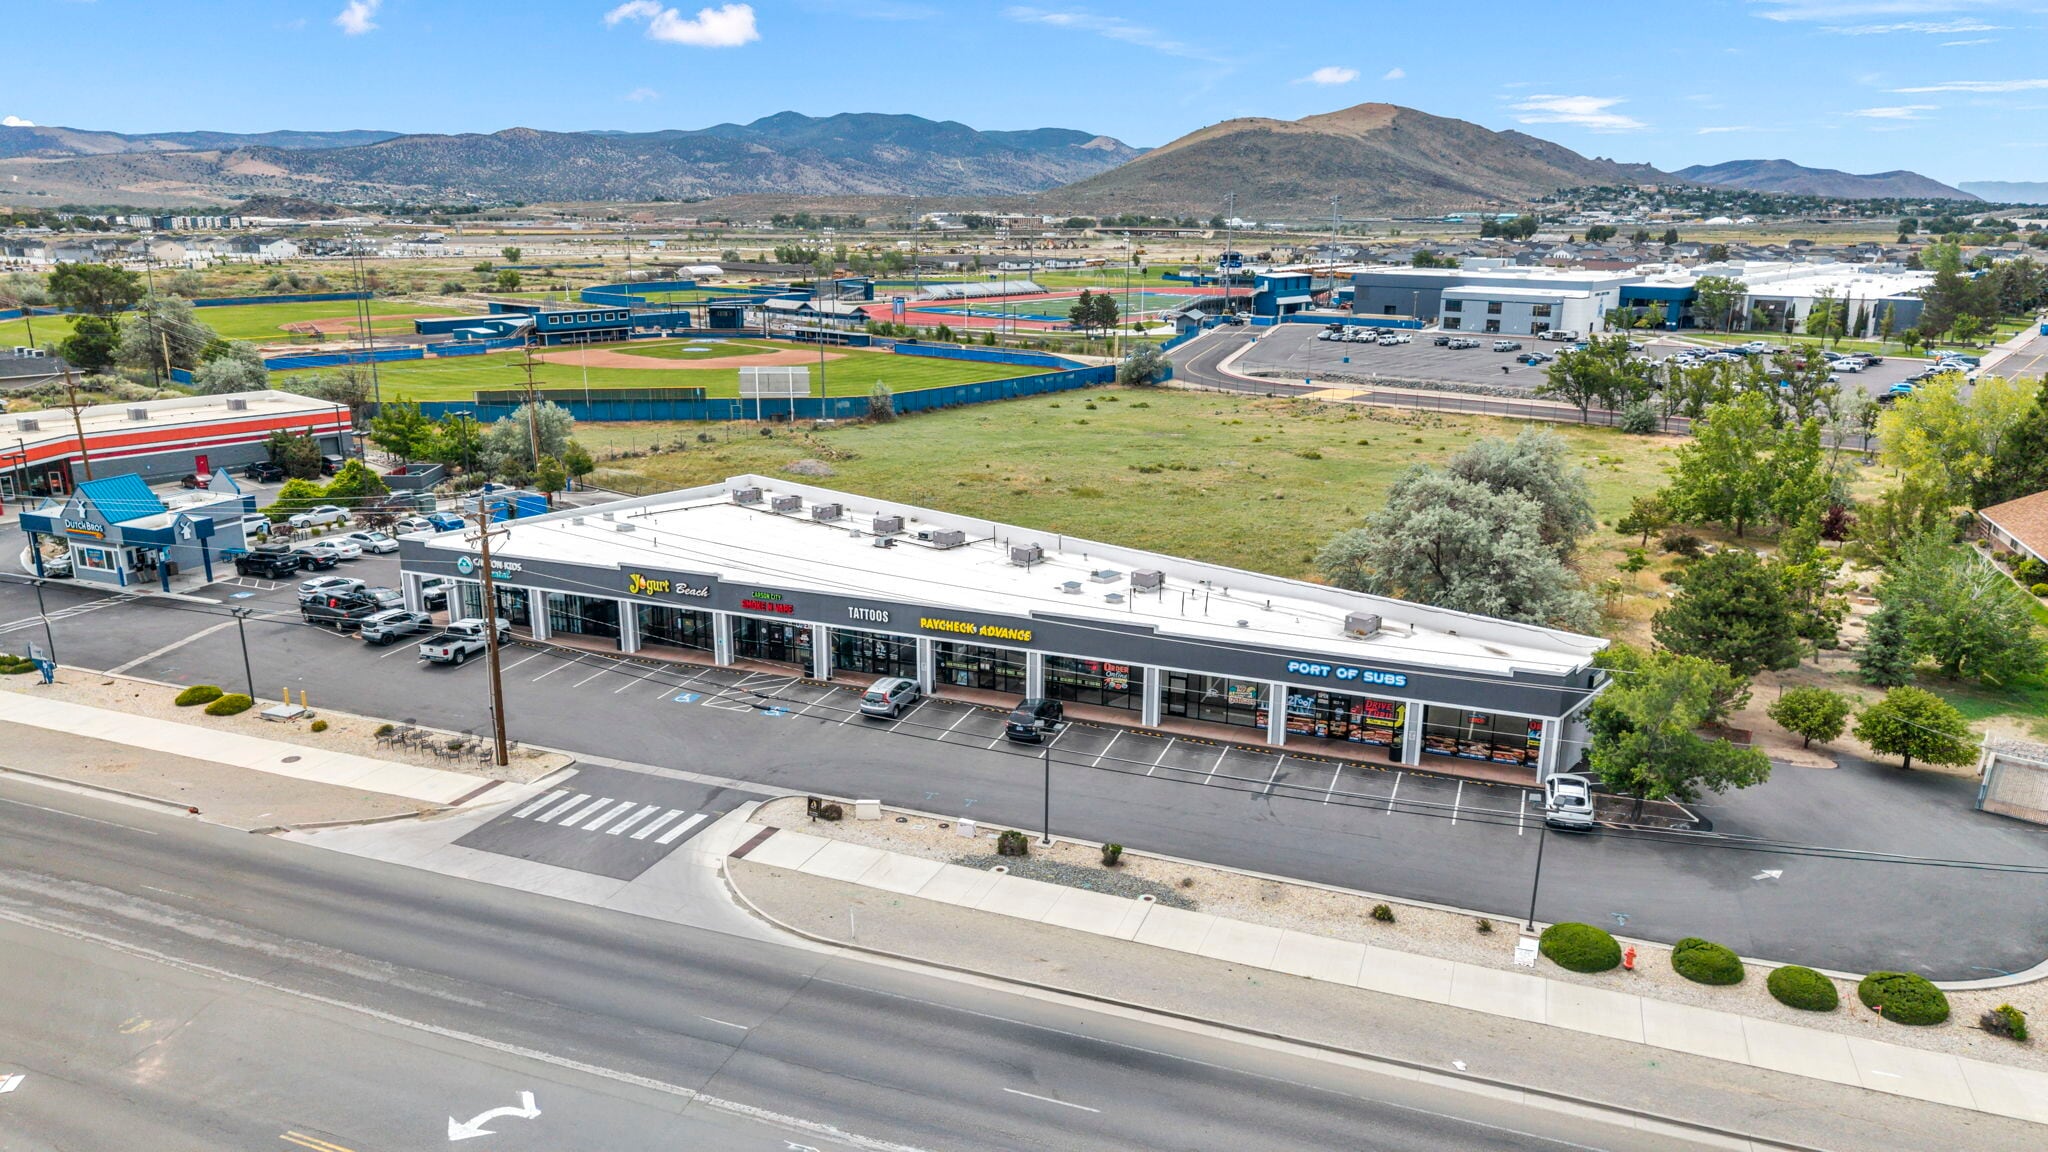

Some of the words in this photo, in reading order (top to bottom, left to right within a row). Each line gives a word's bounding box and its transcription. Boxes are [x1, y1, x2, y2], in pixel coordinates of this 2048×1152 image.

[472, 558, 503, 569] CAON
[504, 561, 522, 572] KIDS
[629, 573, 670, 595] Yogurt
[675, 583, 709, 597] Beach
[751, 592, 770, 600] CARSON
[742, 599, 766, 611] SMOKE
[767, 602, 773, 612] N
[775, 603, 794, 614] VAPE
[848, 606, 889, 623] TATTOOS
[920, 617, 975, 634] PAYCHECK
[979, 625, 1031, 642] ADVANCE
[1103, 662, 1128, 674] ORDER
[1288, 661, 1331, 676] PORT
[1336, 667, 1358, 679] OF
[1363, 671, 1406, 686] SUBS
[1367, 700, 1392, 709] DRIVE
